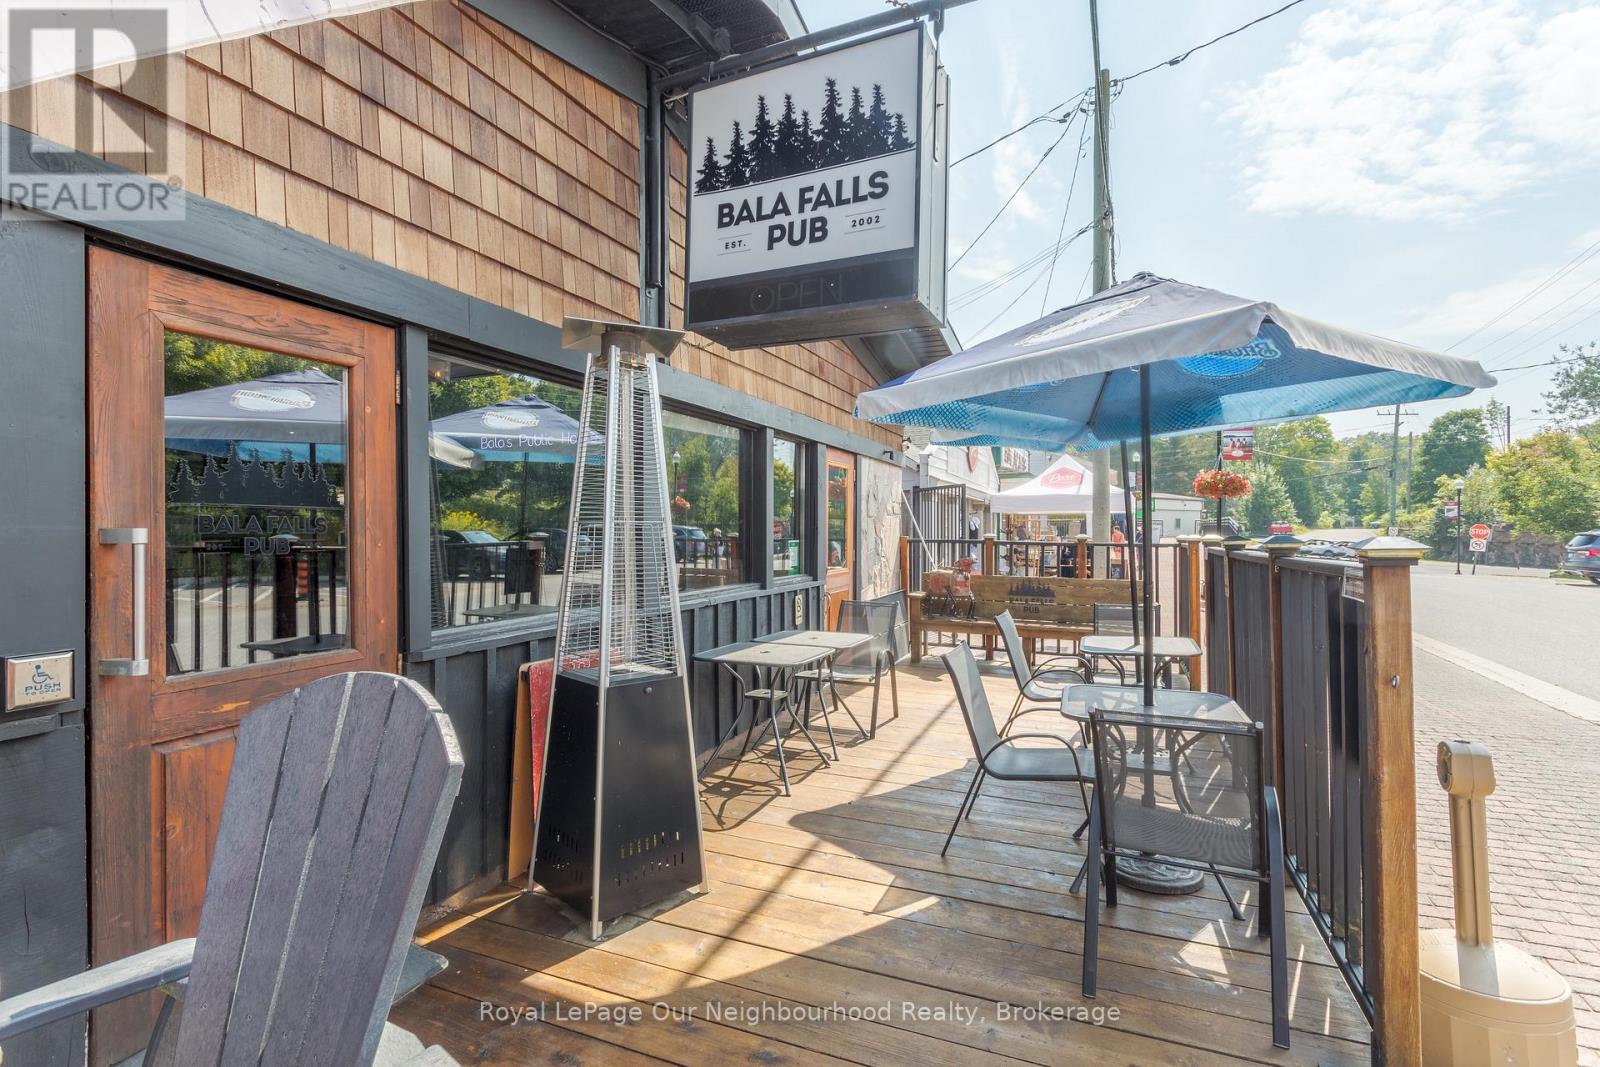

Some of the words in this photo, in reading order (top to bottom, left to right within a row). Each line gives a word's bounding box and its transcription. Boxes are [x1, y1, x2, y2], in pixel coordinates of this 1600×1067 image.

[717, 191, 791, 229] BALA
[798, 170, 889, 214] FALLS
[851, 215, 881, 228] 2002
[767, 216, 829, 251] PUB
[725, 240, 746, 250] EST.
[518, 434, 553, 448] Public
[198, 514, 264, 535] BALA
[266, 514, 328, 534] FALLS
[244, 536, 291, 556] PUB
[1023, 605, 1040, 614] PUB
[25, 682, 61, 693] PUSH
